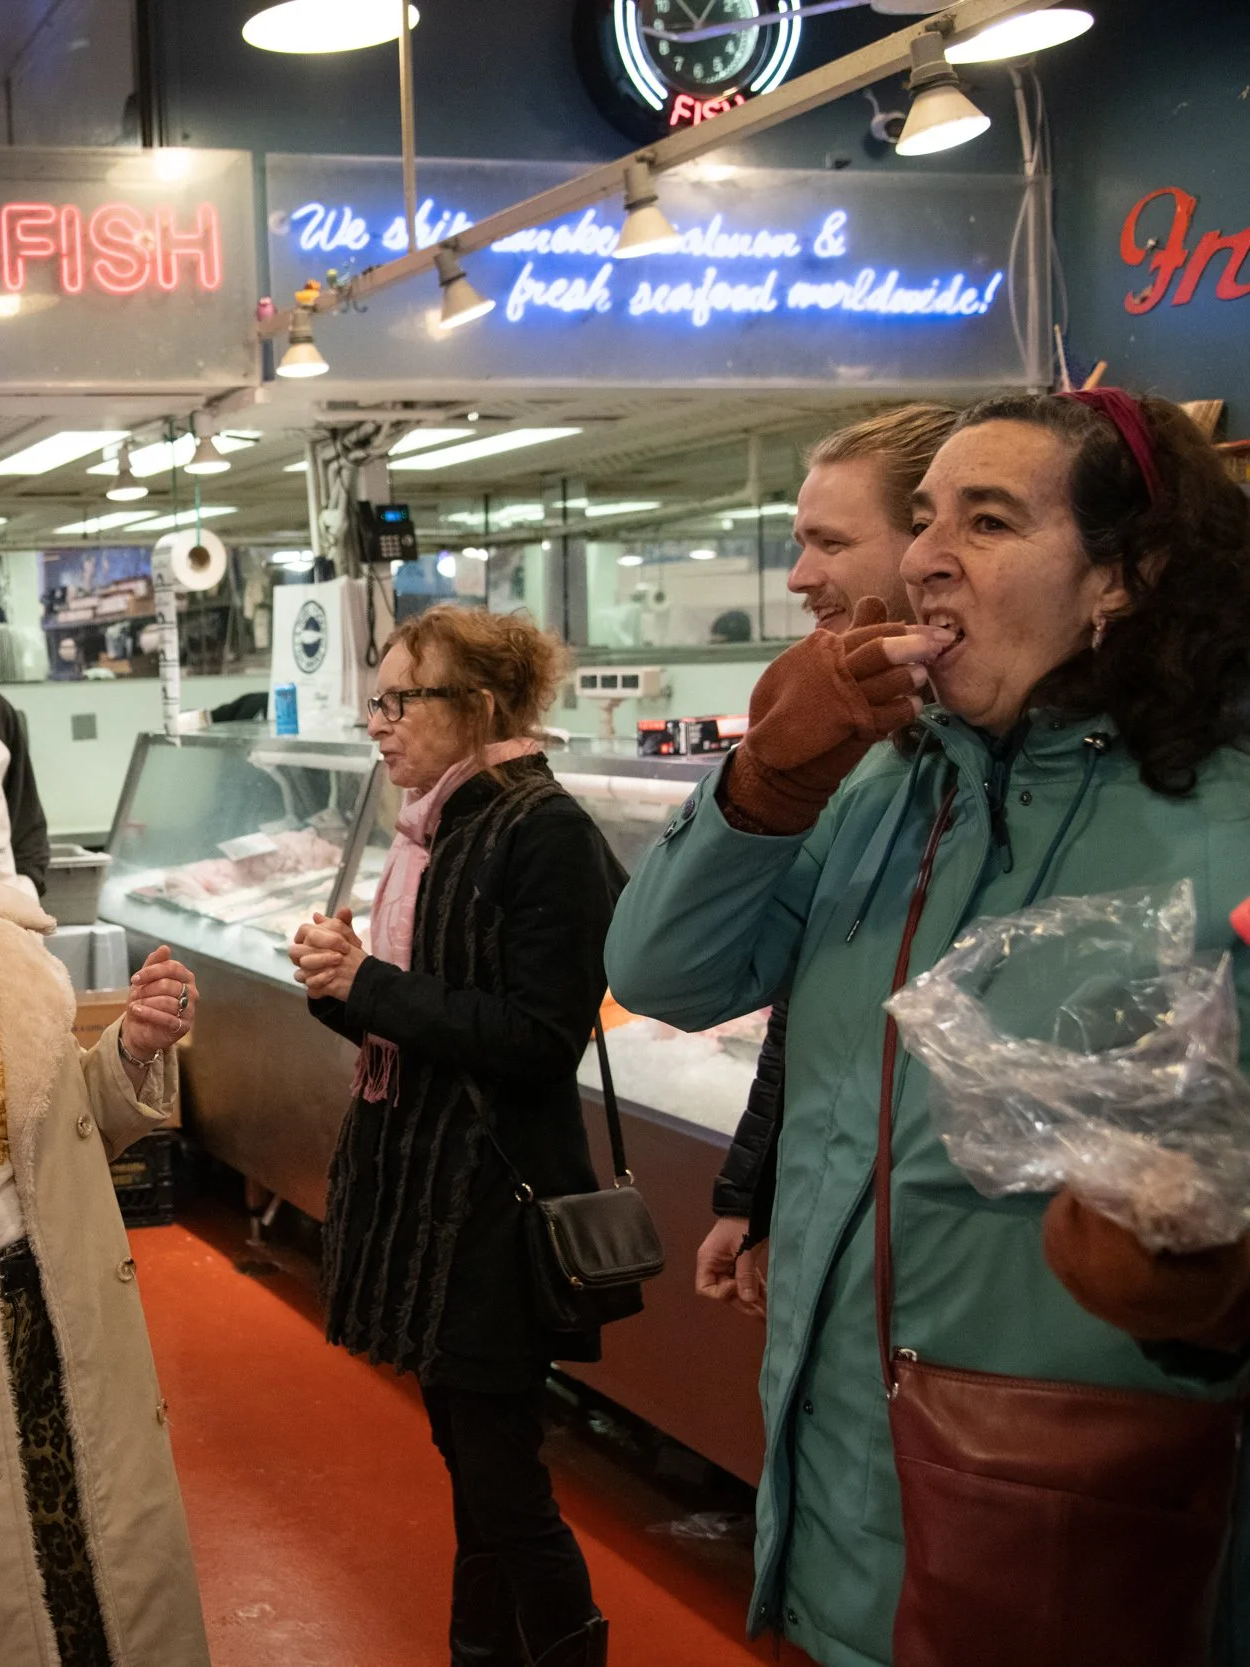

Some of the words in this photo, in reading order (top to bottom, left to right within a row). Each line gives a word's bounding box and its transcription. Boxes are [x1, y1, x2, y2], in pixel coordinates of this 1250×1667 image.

[725, 40, 736, 55] 4
[674, 56, 685, 72] 7
[693, 63, 704, 79] 6
[712, 56, 724, 72] 5
[291, 202, 371, 252] We
[813, 209, 848, 258] &
[0, 202, 224, 294] FISH
[506, 252, 614, 323] fresh
[628, 265, 778, 328] seafood
[786, 266, 1004, 316] worldwide!
